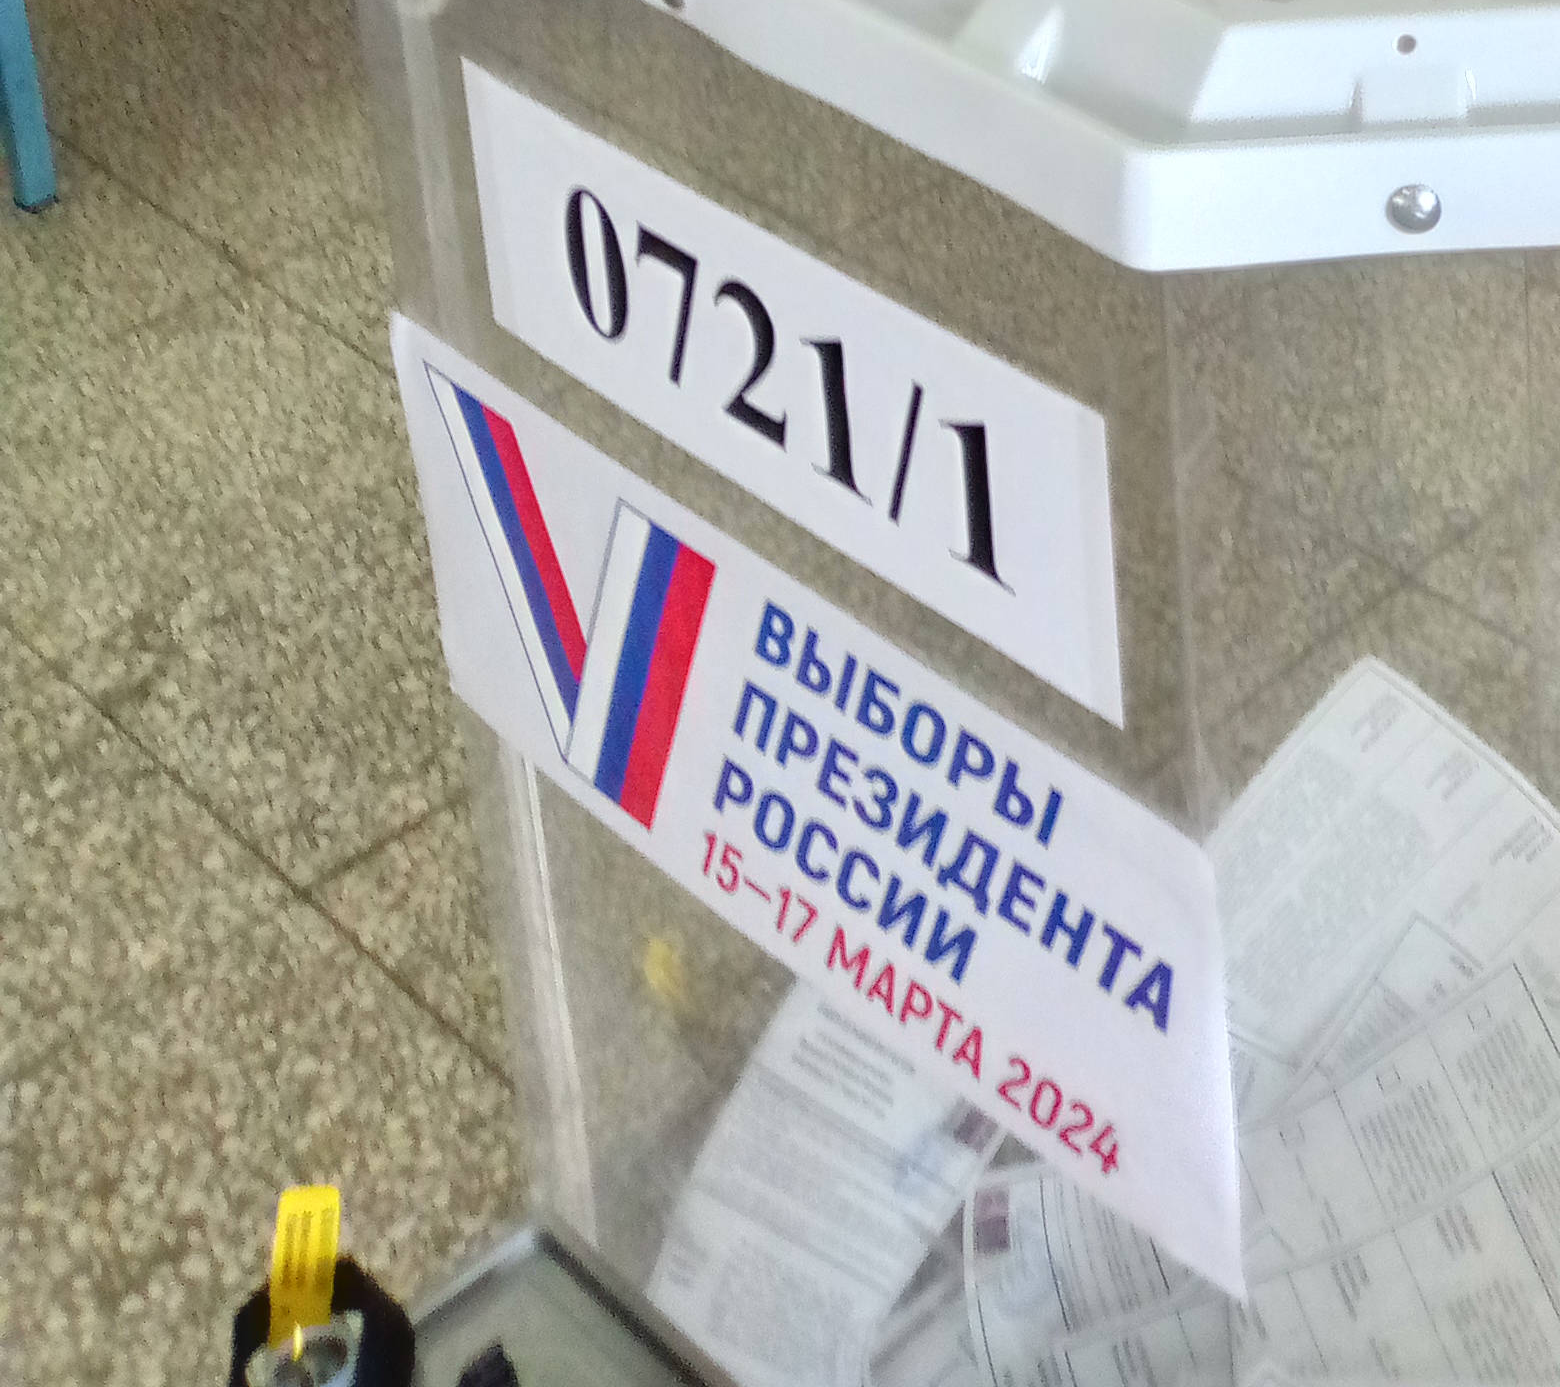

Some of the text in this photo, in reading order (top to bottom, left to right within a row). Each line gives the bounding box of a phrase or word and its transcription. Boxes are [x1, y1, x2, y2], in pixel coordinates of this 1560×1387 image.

[563, 184, 1016, 597] 0721/1
[753, 599, 1065, 849] ВЫБОРЫ
[713, 757, 979, 986] РОССИИ
[732, 680, 1176, 1035] ПРЕЗИДЕНТА
[826, 926, 986, 1082] МАРТА
[995, 1055, 1121, 1175] 2024
